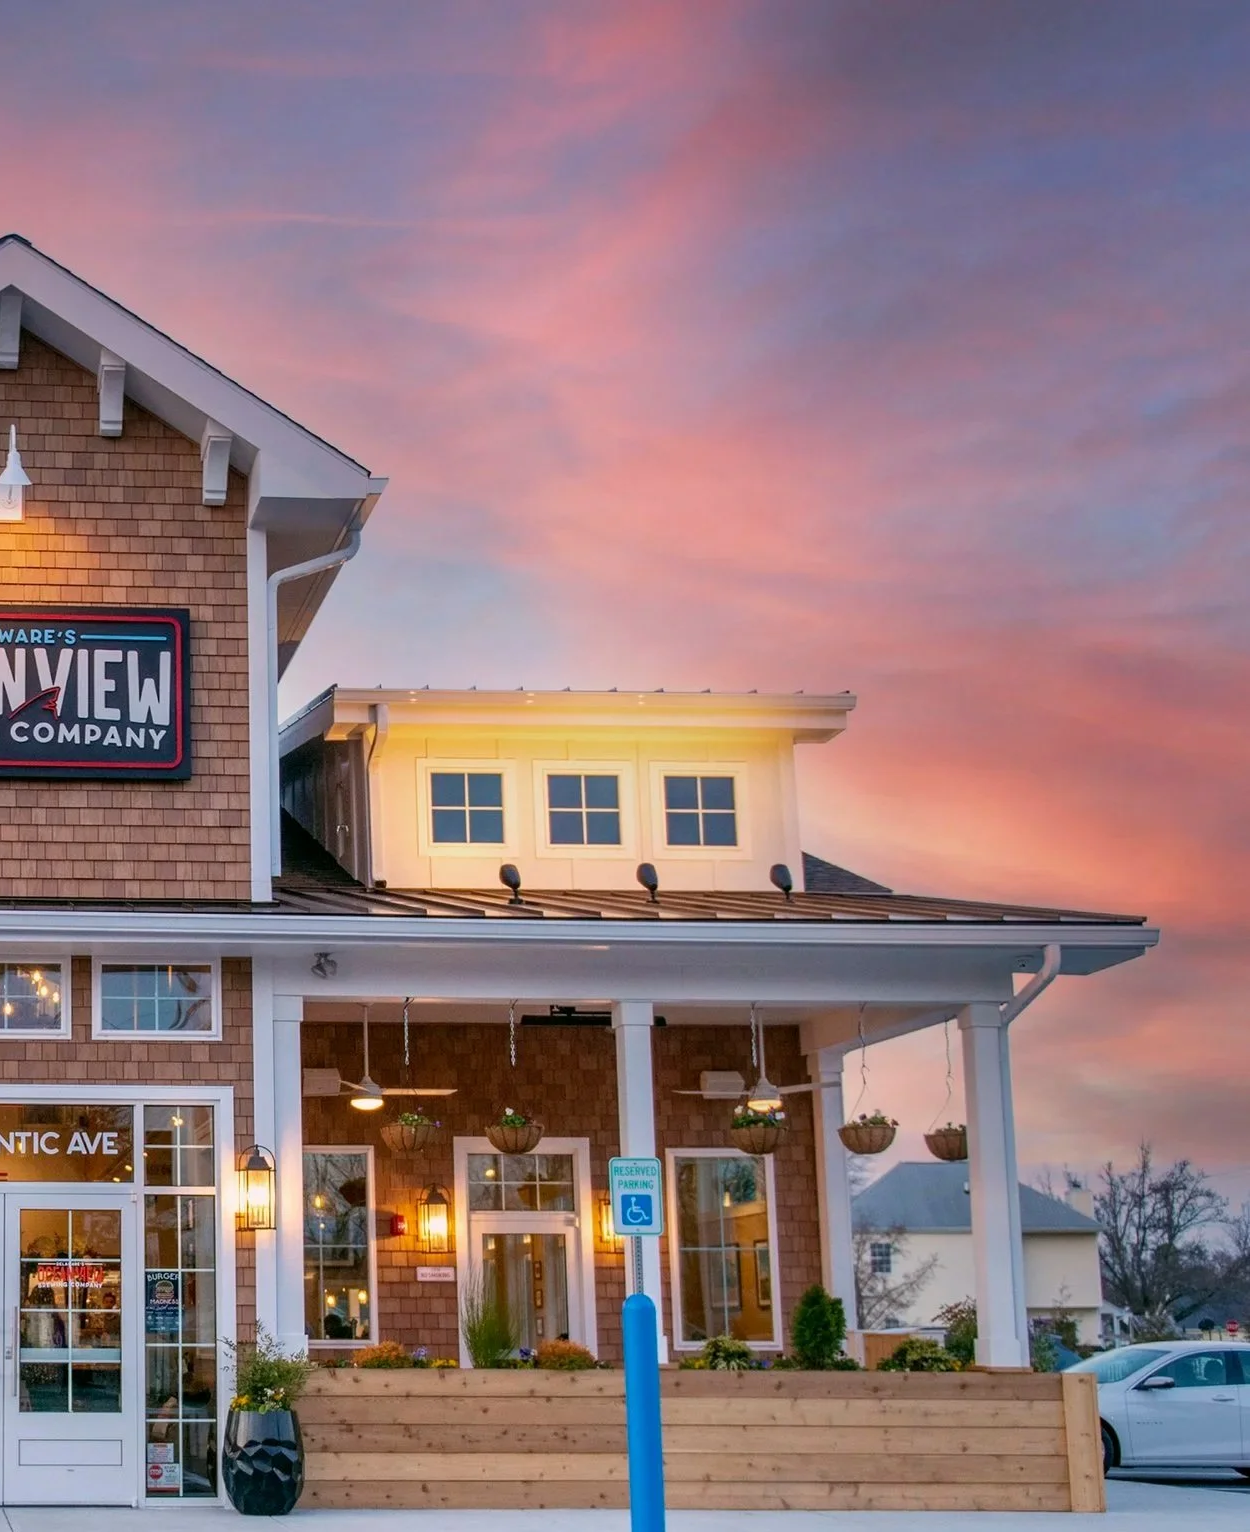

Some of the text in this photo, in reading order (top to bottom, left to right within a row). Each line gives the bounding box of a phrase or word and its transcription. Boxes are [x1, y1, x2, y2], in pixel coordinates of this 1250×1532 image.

[10, 721, 167, 750] COMPANY
[66, 1132, 119, 1155] AVE
[614, 1166, 657, 1176] RESERVED
[618, 1180, 654, 1190] PARKING
